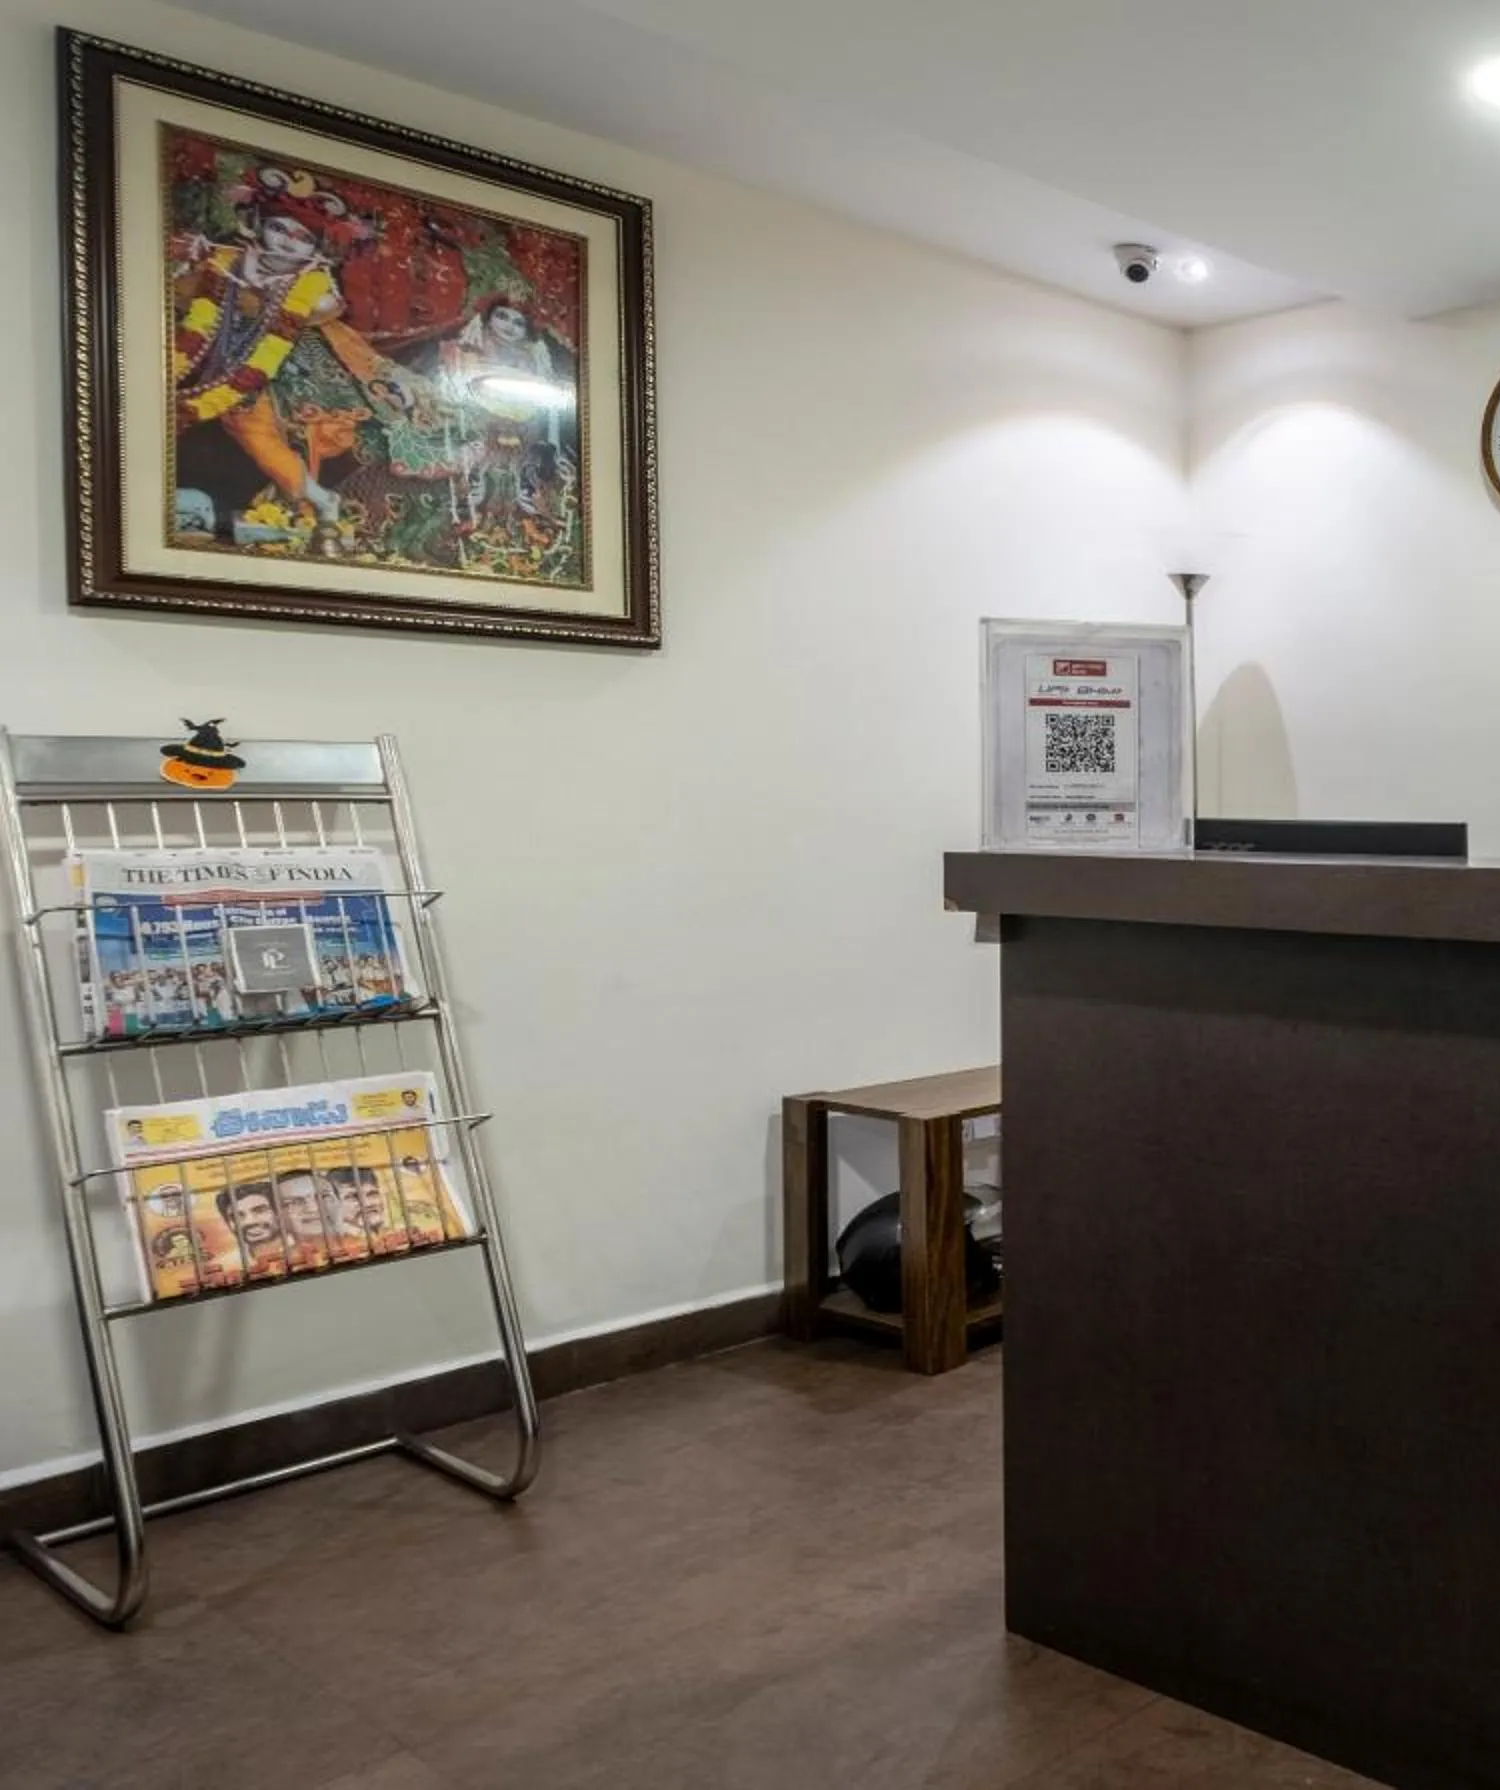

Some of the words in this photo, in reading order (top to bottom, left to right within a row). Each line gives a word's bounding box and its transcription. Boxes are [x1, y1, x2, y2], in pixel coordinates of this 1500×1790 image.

[122, 866, 174, 884] THE
[177, 860, 249, 882] TIMES
[285, 866, 353, 881] INDIA
